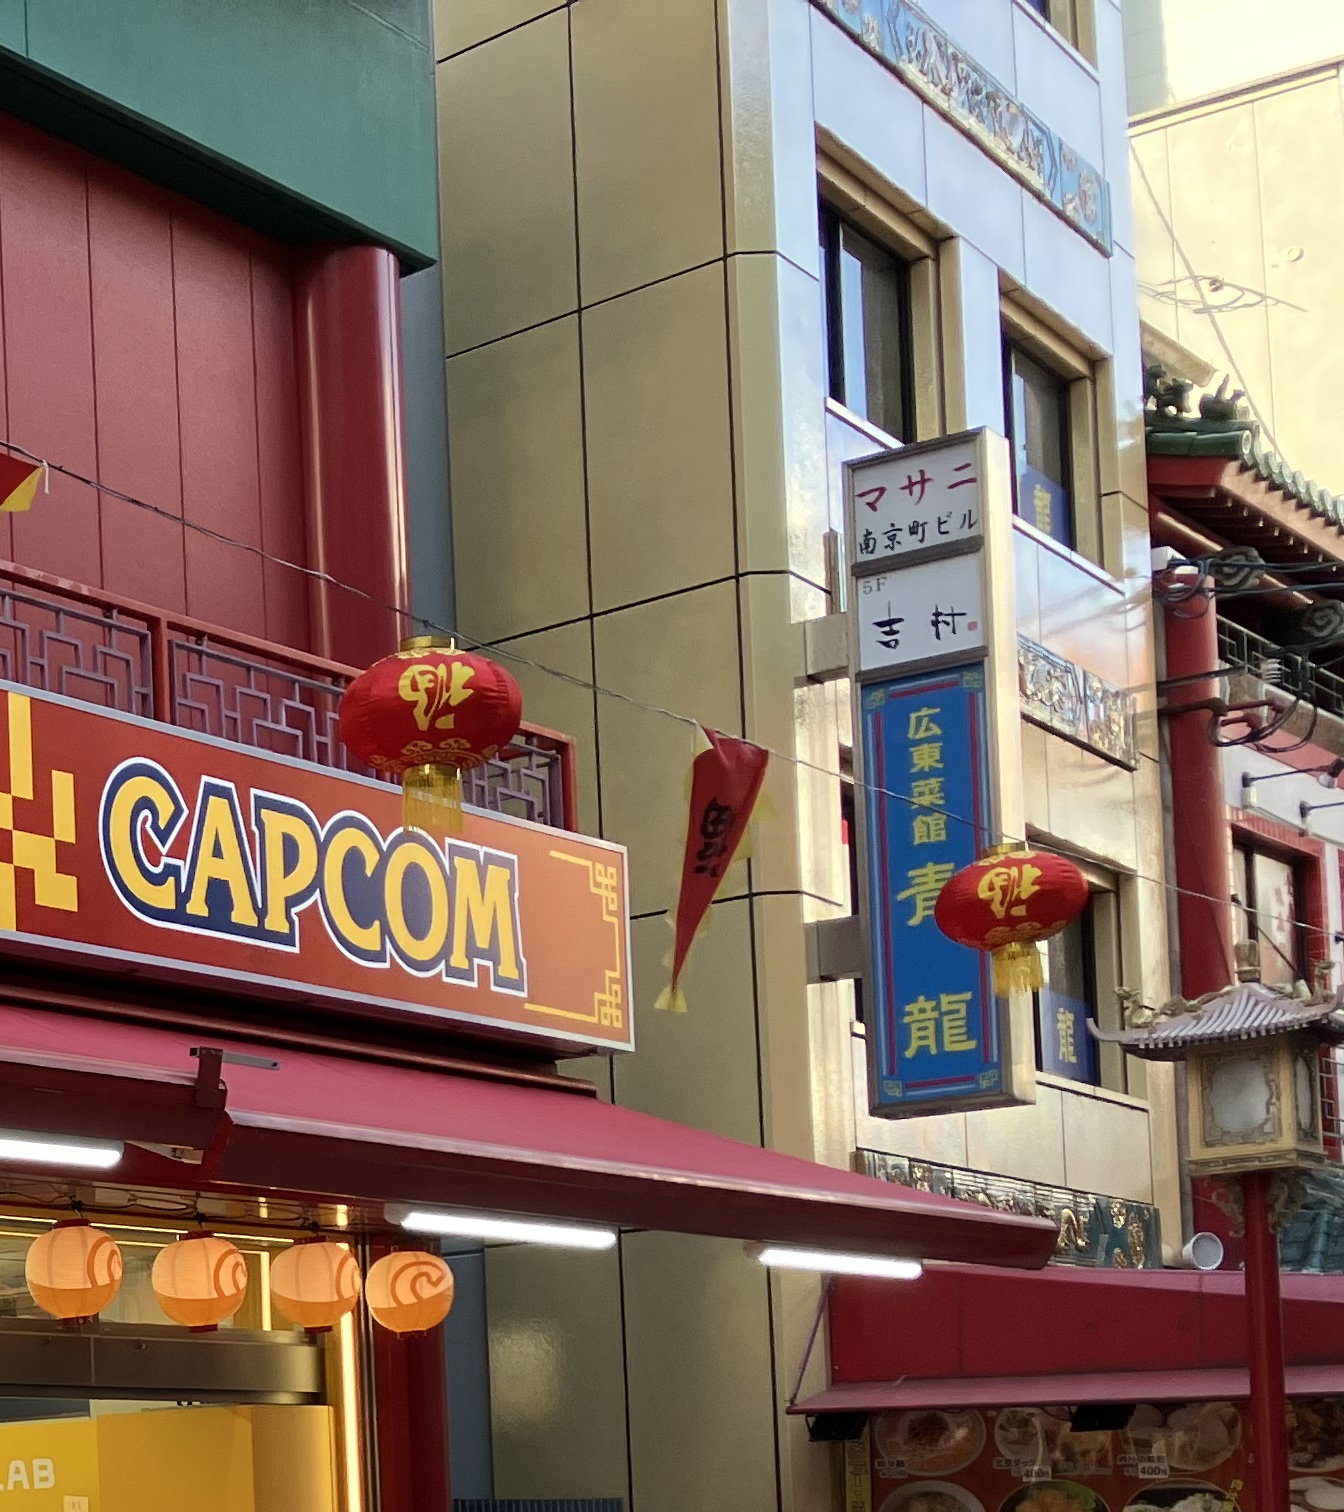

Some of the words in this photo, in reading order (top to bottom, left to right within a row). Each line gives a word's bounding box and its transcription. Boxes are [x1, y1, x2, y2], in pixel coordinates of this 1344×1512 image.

[855, 462, 977, 512] マサニ
[859, 509, 978, 555] 南京町ビル
[862, 577, 888, 595] 5F
[906, 706, 948, 847] 広東菜館
[100, 758, 527, 997] CAPCOM
